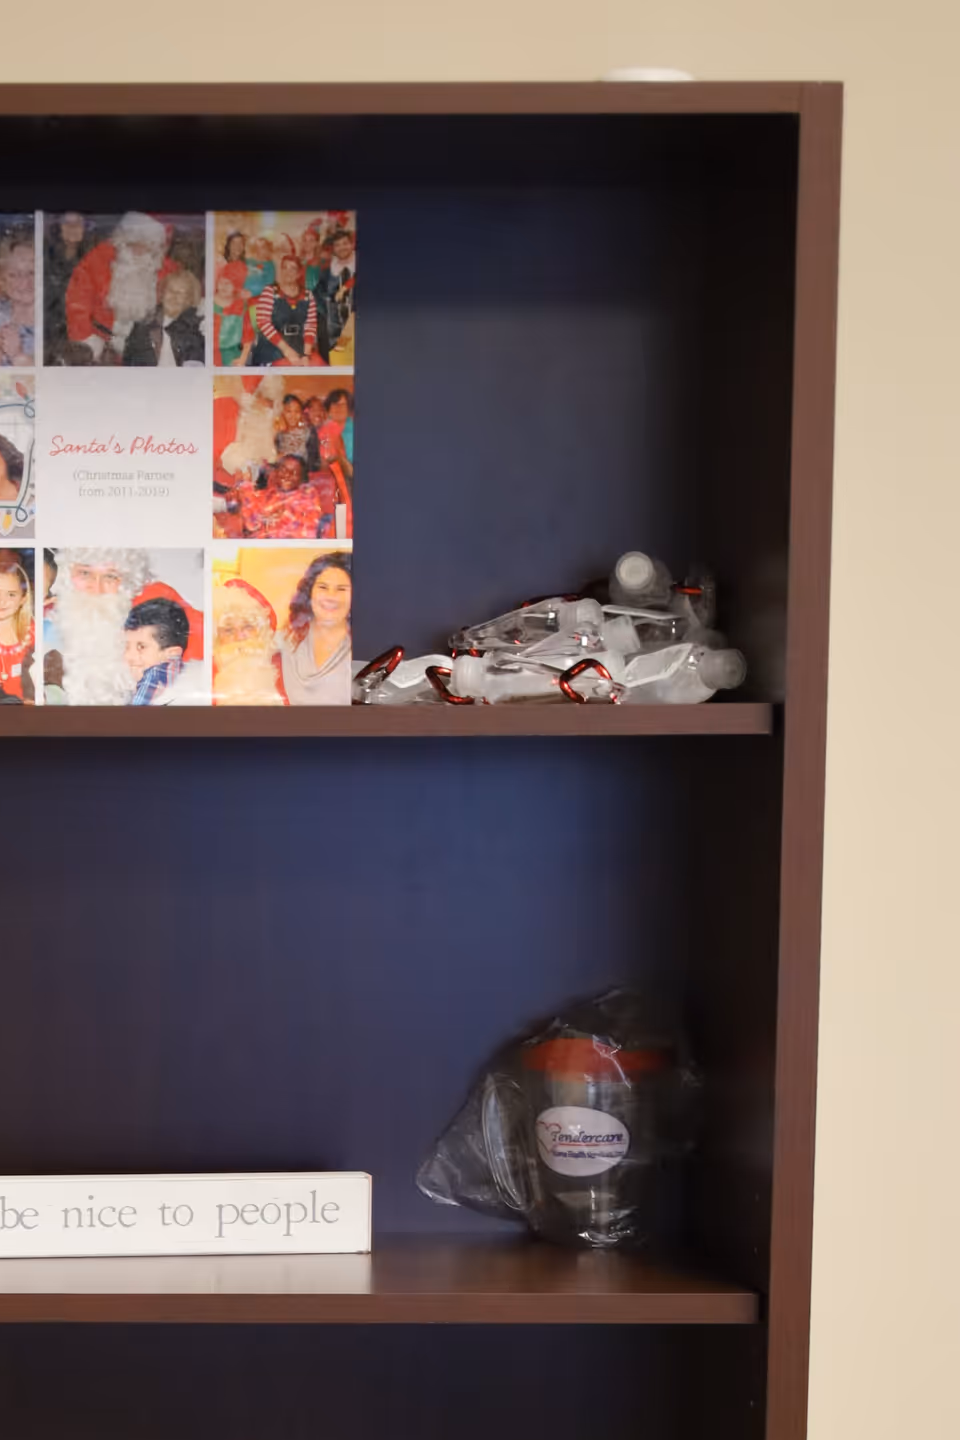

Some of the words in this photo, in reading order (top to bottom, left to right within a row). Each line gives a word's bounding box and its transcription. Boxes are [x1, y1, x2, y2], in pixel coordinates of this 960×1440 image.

[48, 434, 125, 456] Santa's
[129, 434, 199, 455] Photos
[550, 1130, 623, 1143] Tendercare
[61, 1194, 138, 1229] nice
[158, 1201, 194, 1226] to
[214, 1189, 340, 1238] people
